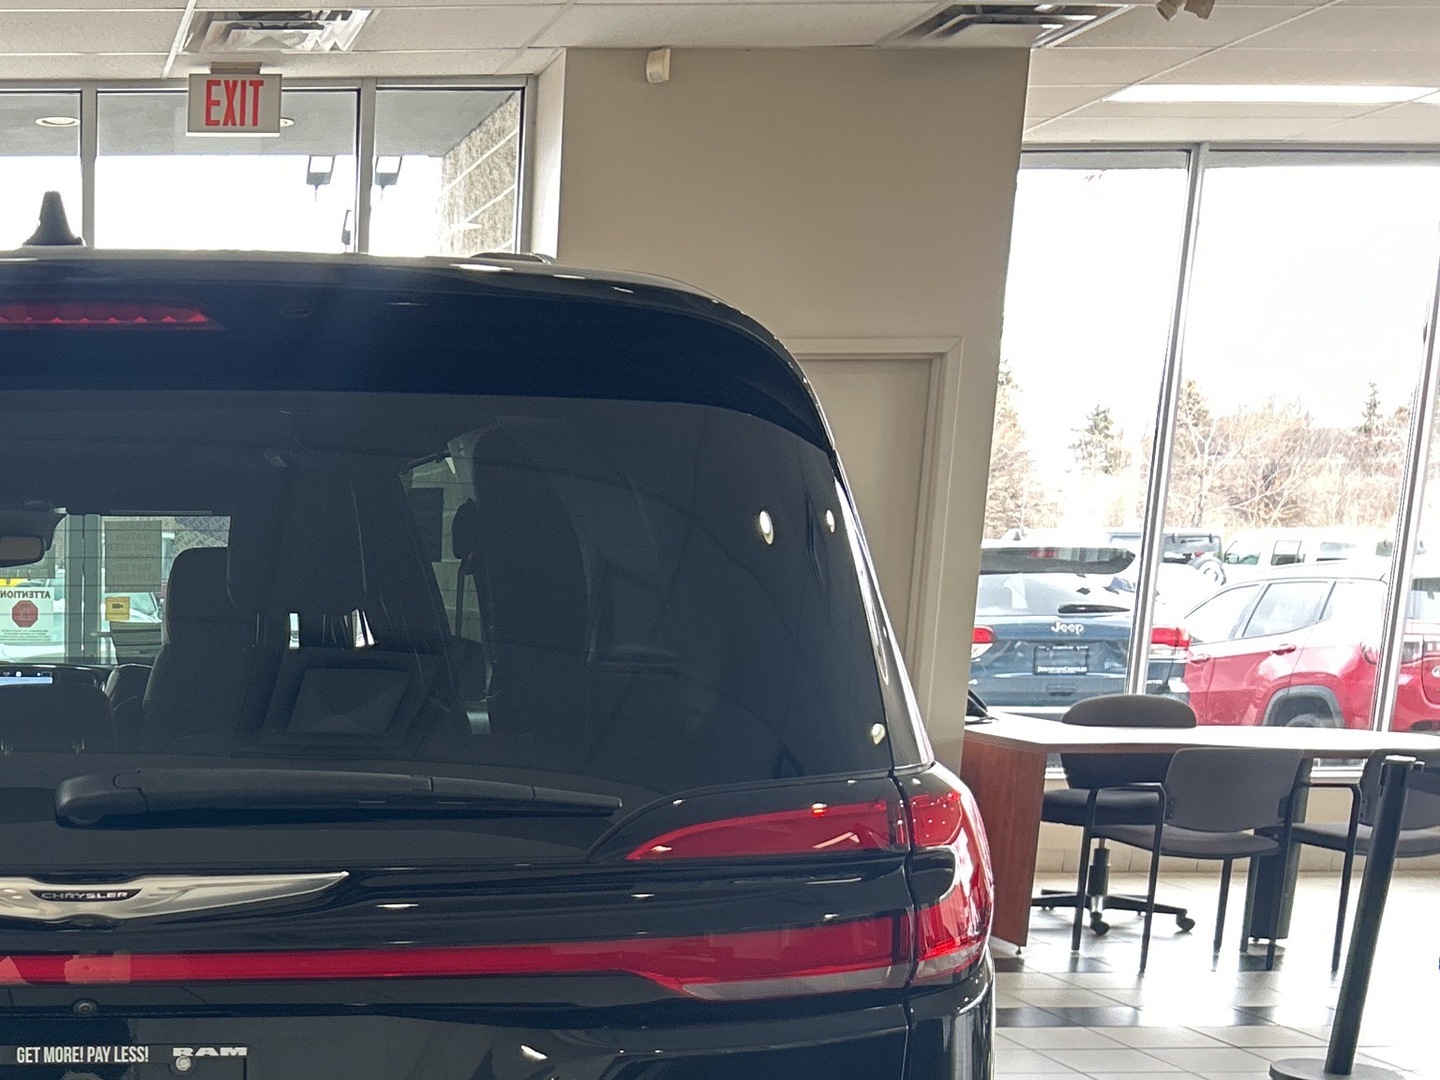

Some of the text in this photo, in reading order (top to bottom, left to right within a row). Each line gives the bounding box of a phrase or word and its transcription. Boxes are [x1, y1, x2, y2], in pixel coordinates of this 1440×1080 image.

[205, 80, 264, 126] EXIT
[1050, 621, 1084, 635] Jeep
[40, 892, 129, 900] CHRYSLER
[16, 1046, 149, 1063] GET MORE! PAY LESS!
[173, 1047, 247, 1057] RAM
